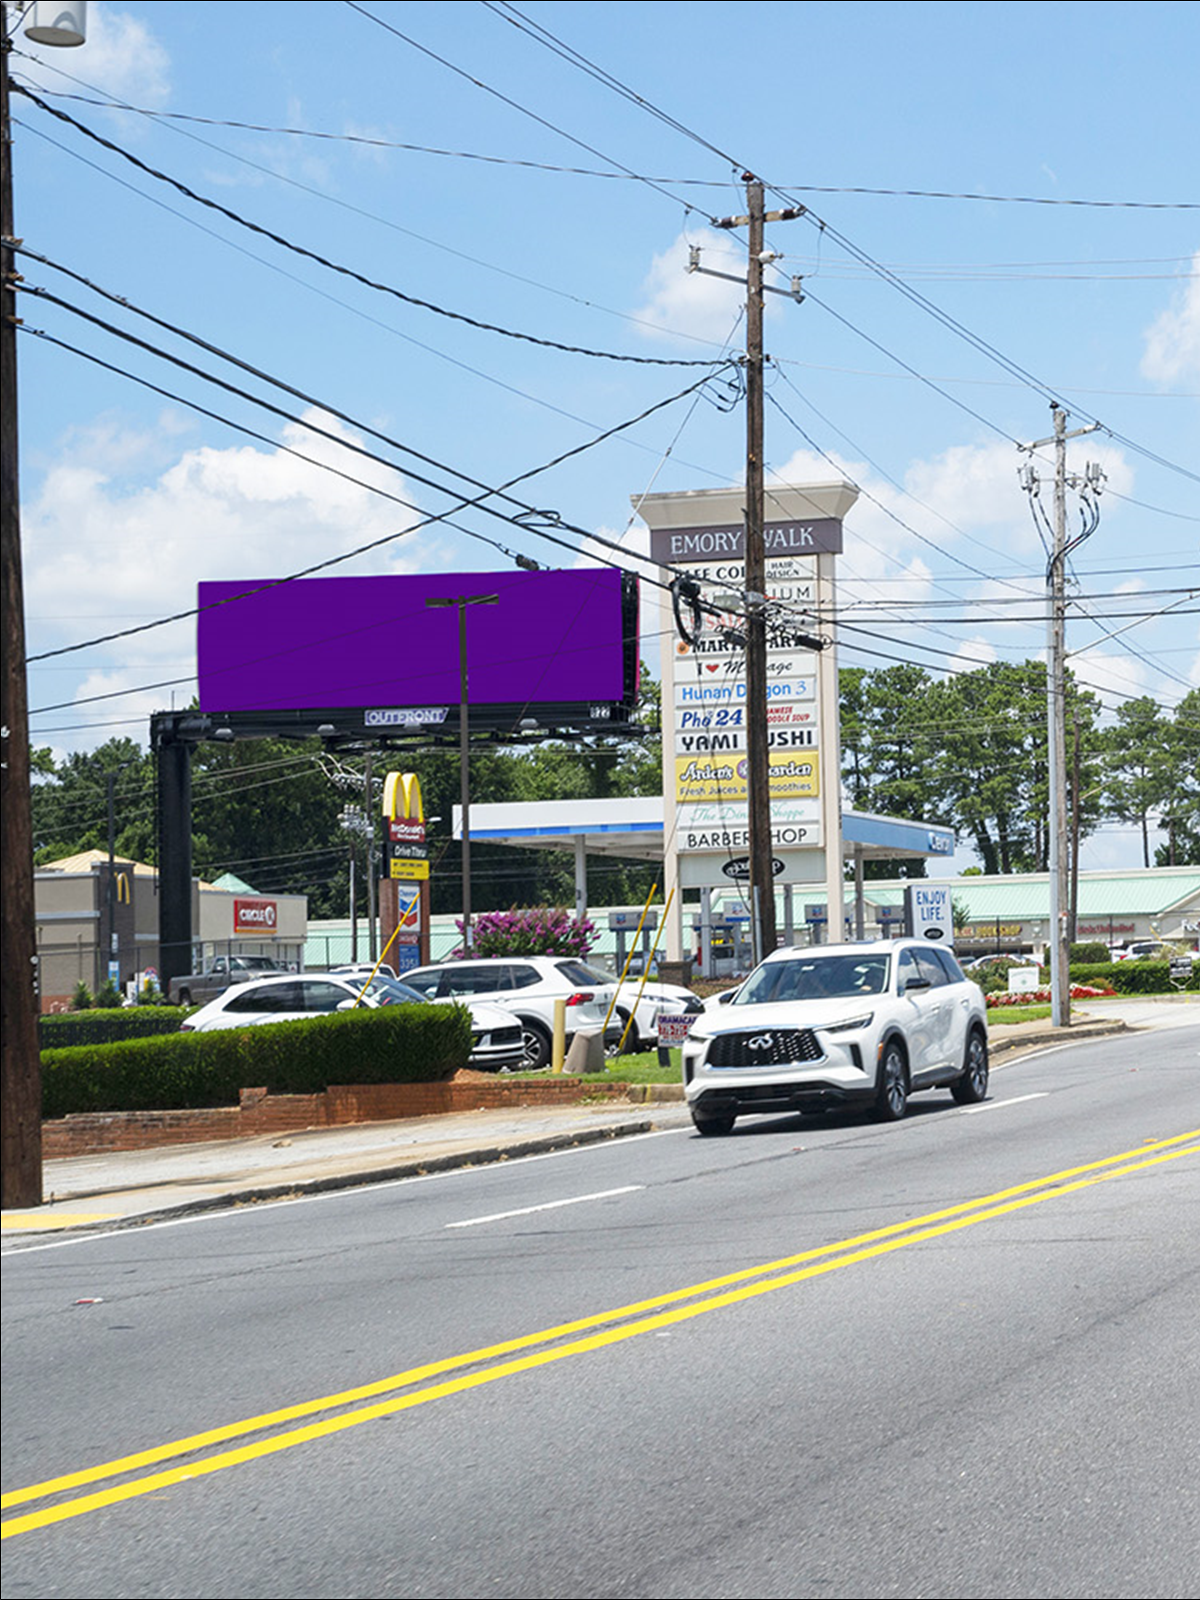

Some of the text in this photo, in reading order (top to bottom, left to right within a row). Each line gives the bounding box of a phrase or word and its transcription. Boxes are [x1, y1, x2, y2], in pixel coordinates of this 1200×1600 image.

[670, 531, 741, 555] EMORY
[682, 680, 807, 701] Hunan Dgon 3
[368, 709, 444, 725] OUTFRONT
[715, 708, 743, 726] 24
[766, 714, 790, 724] OODLE
[682, 730, 812, 751] YAMI USHI
[679, 761, 812, 782] Arden's arden
[680, 786, 706, 796] Fresh
[709, 784, 739, 796] Juices
[769, 783, 811, 794] moothies
[691, 805, 716, 822] The
[688, 828, 807, 848] BARBER HOP
[916, 890, 947, 905] ENJOY
[921, 906, 945, 921] LIFE.
